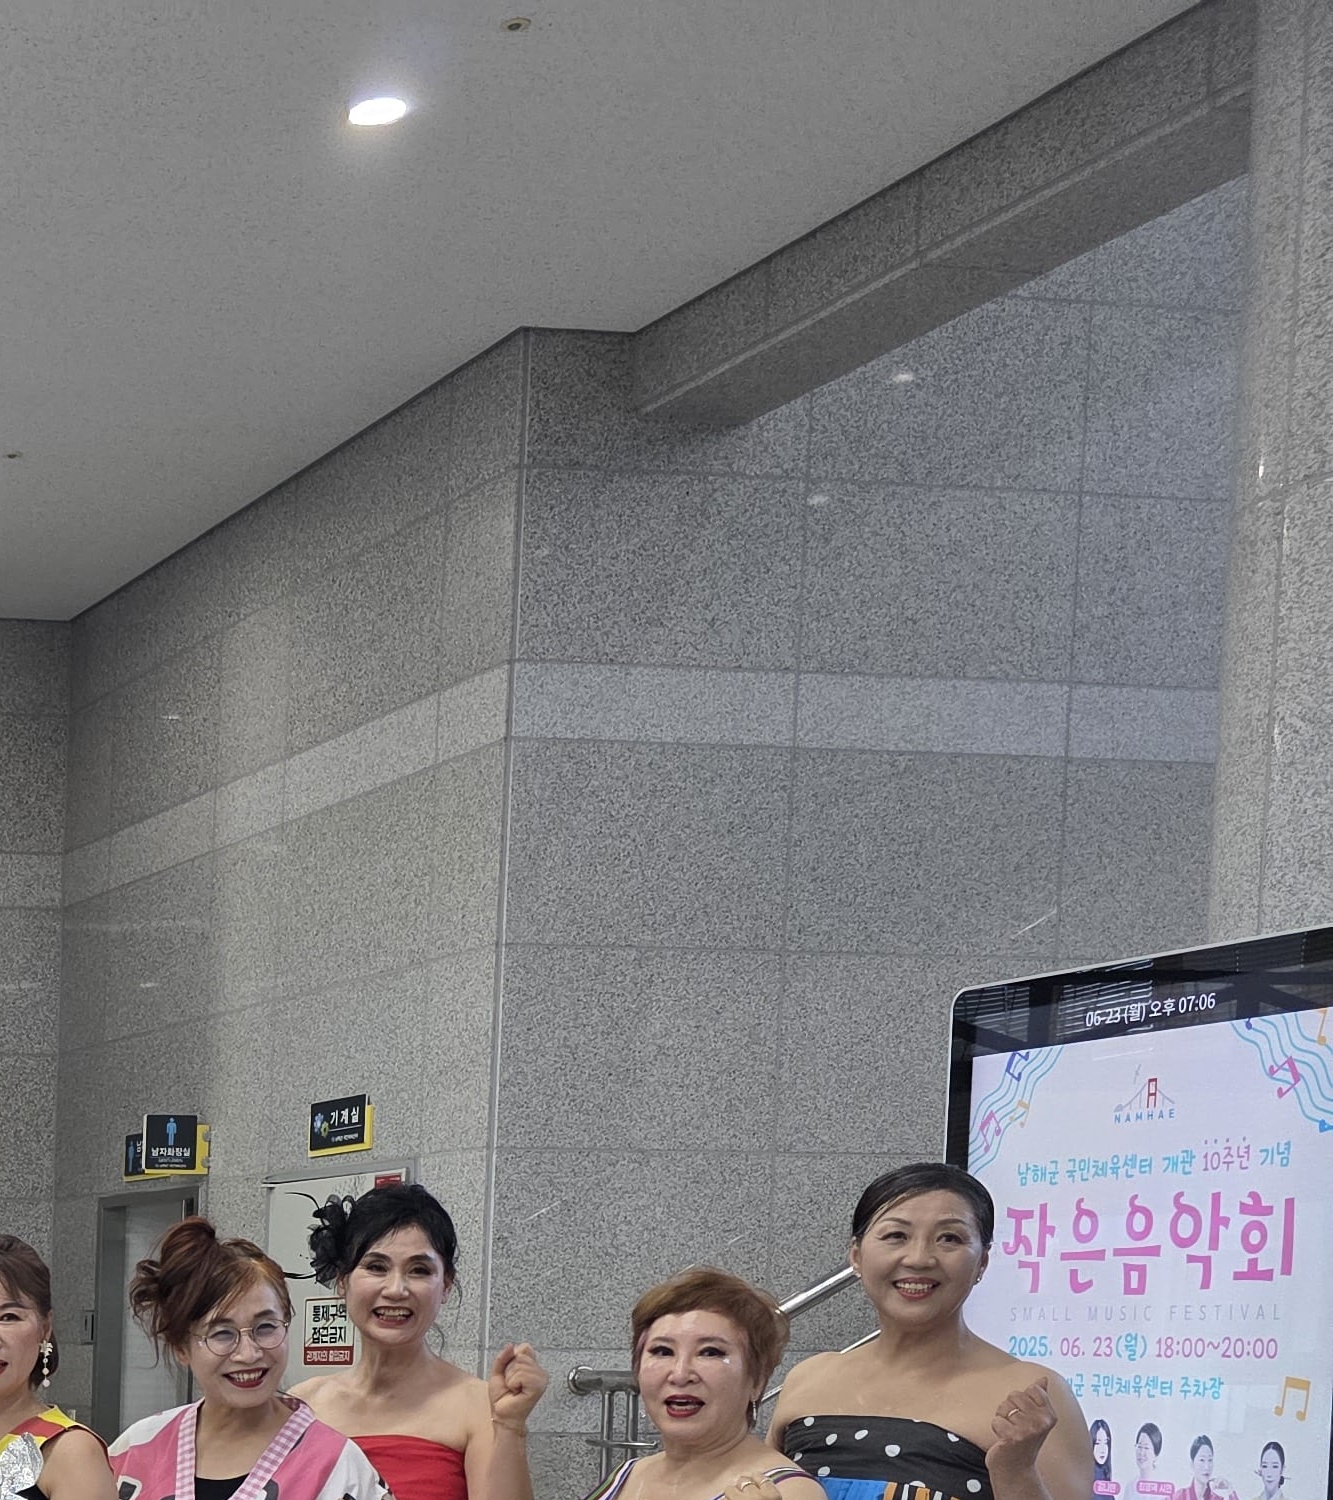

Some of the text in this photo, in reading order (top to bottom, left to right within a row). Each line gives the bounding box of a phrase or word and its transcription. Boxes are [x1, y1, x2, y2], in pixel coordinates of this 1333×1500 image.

[1149, 998, 1176, 1017] 오후
[1178, 993, 1216, 1013] 07:06
[330, 1106, 360, 1125] 기계실
[1114, 1109, 1175, 1124] NAMHAE
[151, 1147, 191, 1157] 남자화장실
[1017, 1140, 1292, 1187] 남해군 국민체육센터 개관 10주년 기념
[1010, 1303, 1282, 1322] SMALL MUSIC FESTIVAL
[311, 1326, 347, 1344] 접근금지
[1008, 1335, 1053, 1357] 2025.
[1060, 1336, 1085, 1358] 06.
[1155, 1336, 1278, 1360] 18:00~20:00
[1090, 1373, 1173, 1400] 국민체육센터
[1179, 1375, 1225, 1400] 주차장
